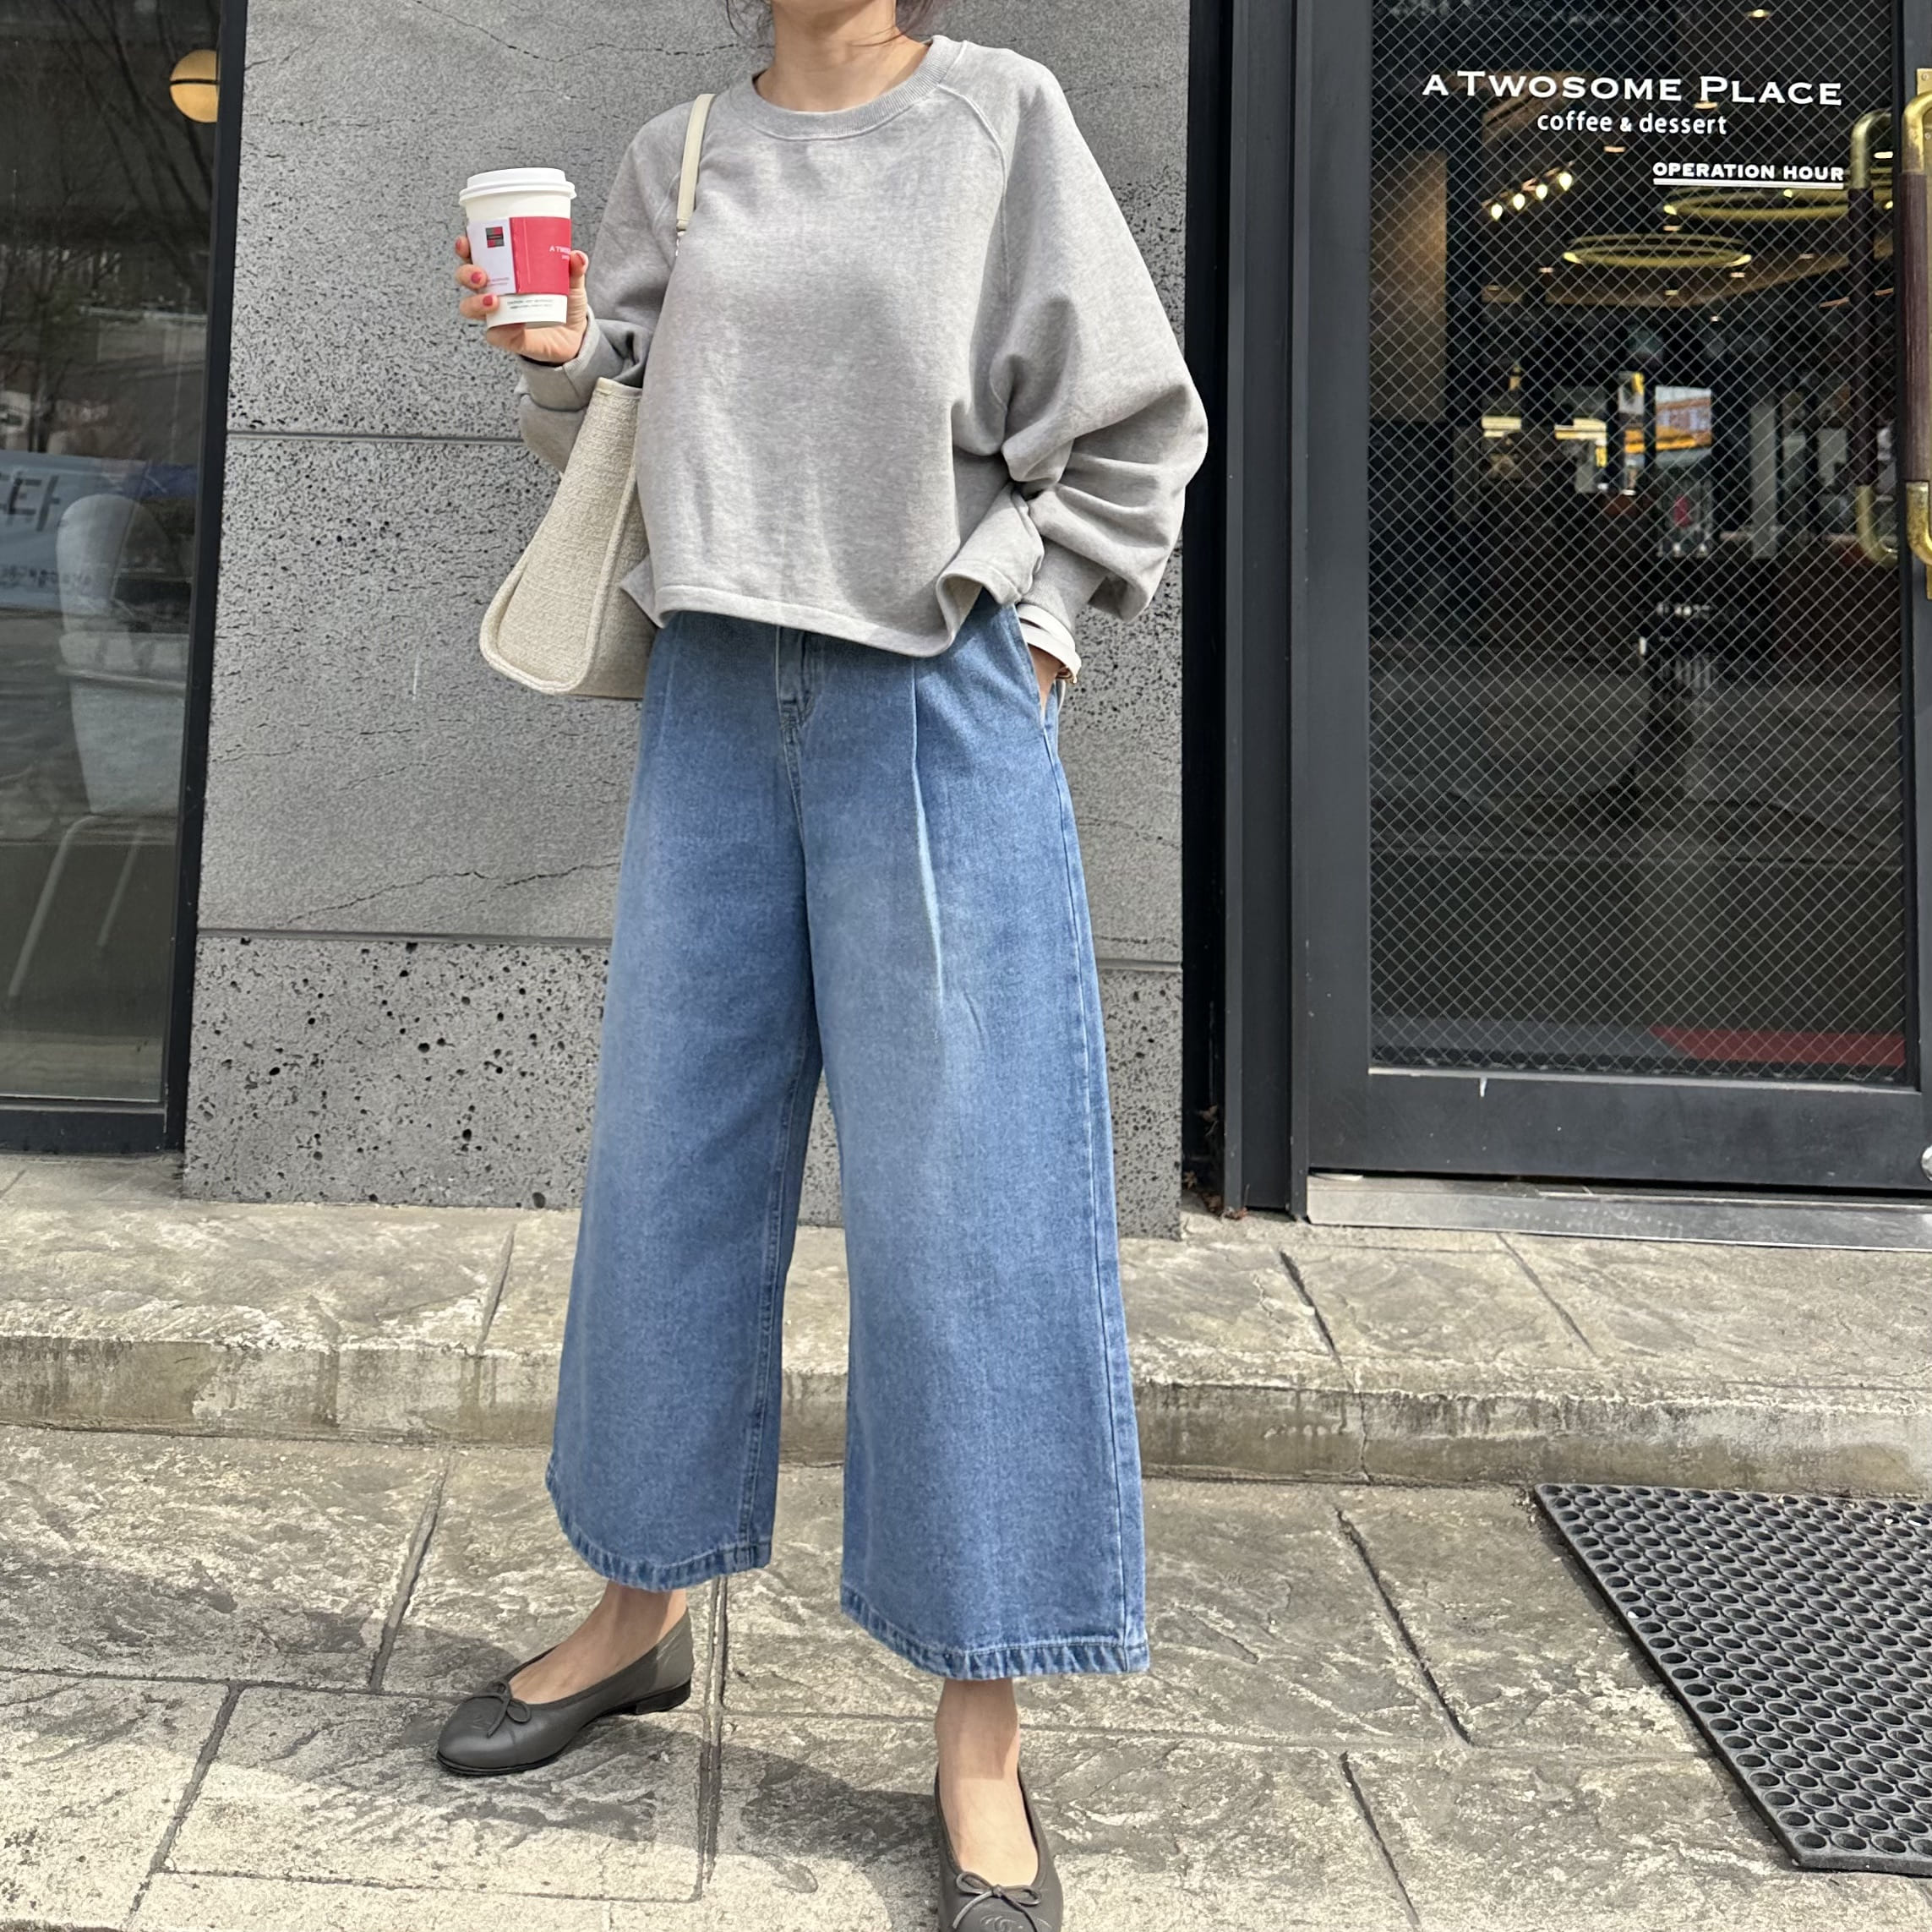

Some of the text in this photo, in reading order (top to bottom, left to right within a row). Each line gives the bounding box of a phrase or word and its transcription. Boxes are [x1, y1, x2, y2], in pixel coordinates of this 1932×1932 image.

[1422, 70, 1842, 106] A TWOSOME PLACE
[1537, 110, 1727, 135] coffee & dessert
[1652, 161, 1844, 181] OPERATION HOUR
